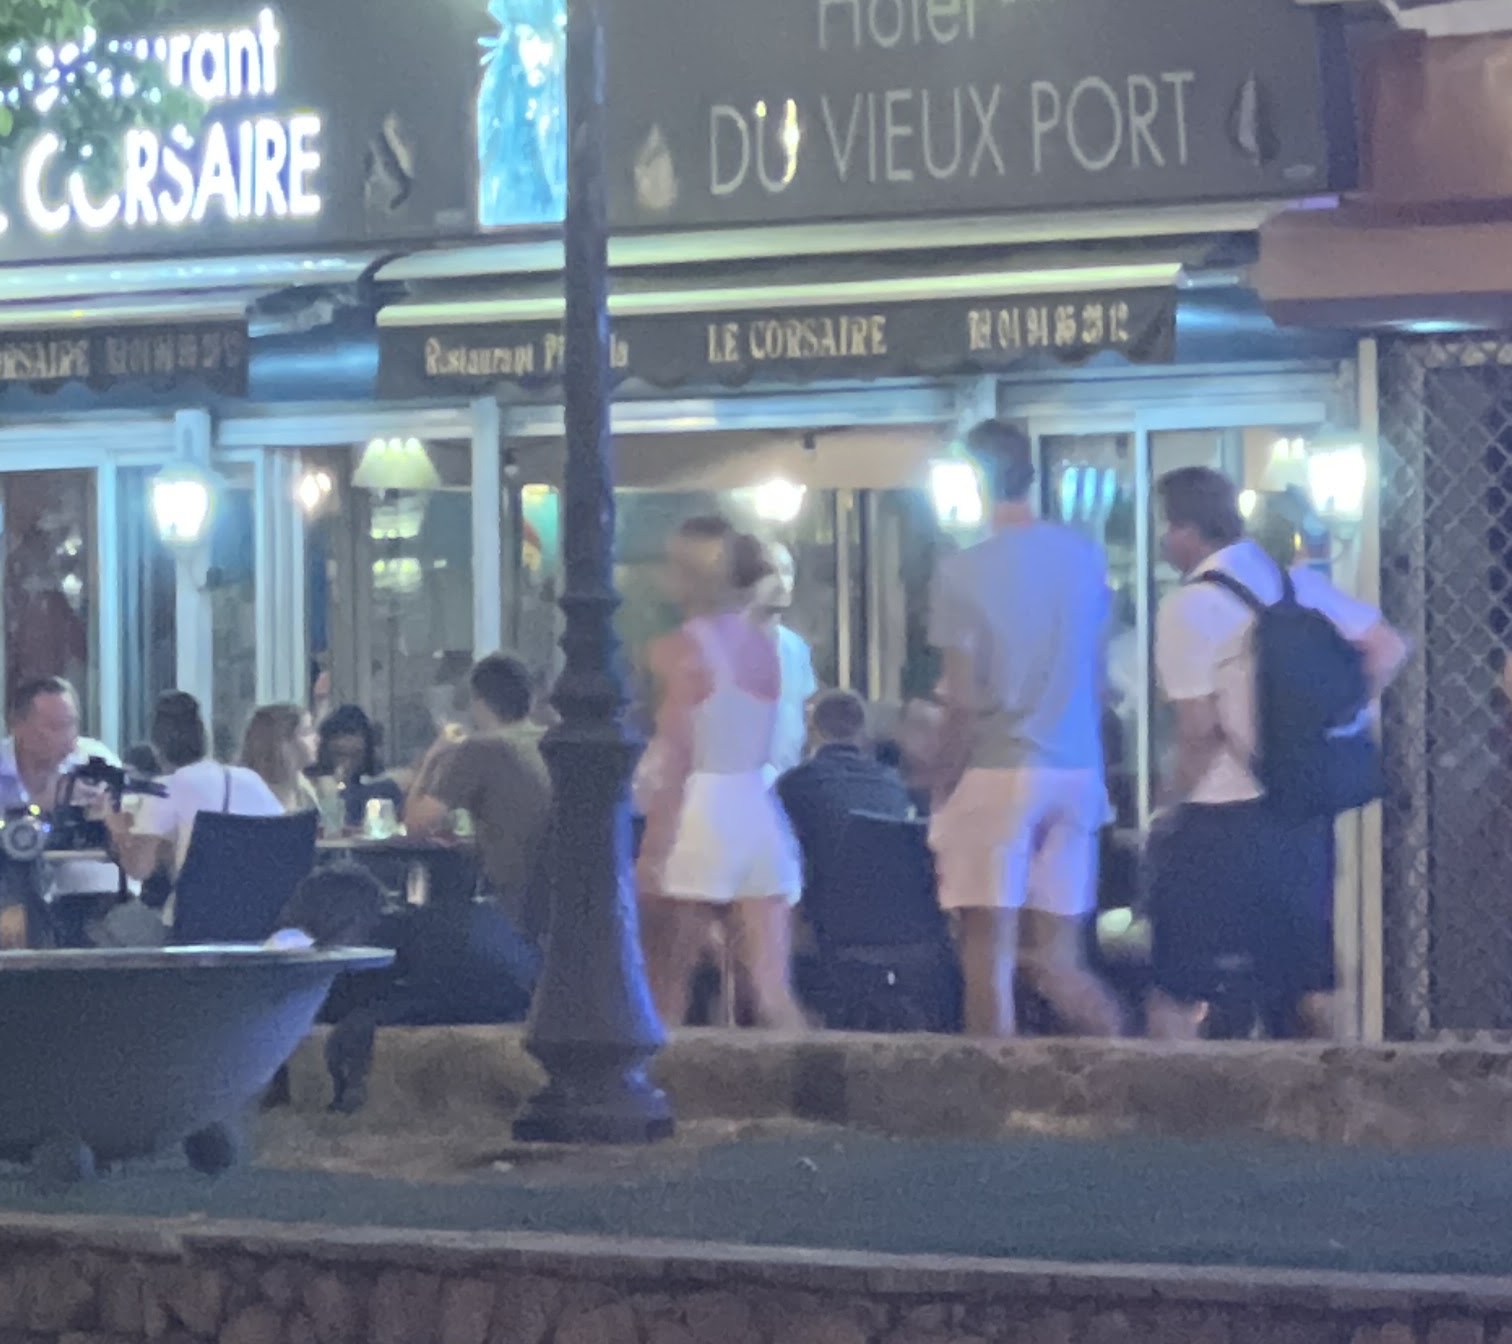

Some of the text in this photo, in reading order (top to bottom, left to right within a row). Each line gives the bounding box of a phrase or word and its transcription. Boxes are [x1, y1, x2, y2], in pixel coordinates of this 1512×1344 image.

[709, 70, 1195, 197] DU VIEUX PORT
[708, 314, 888, 364] LE CORSAIRE
